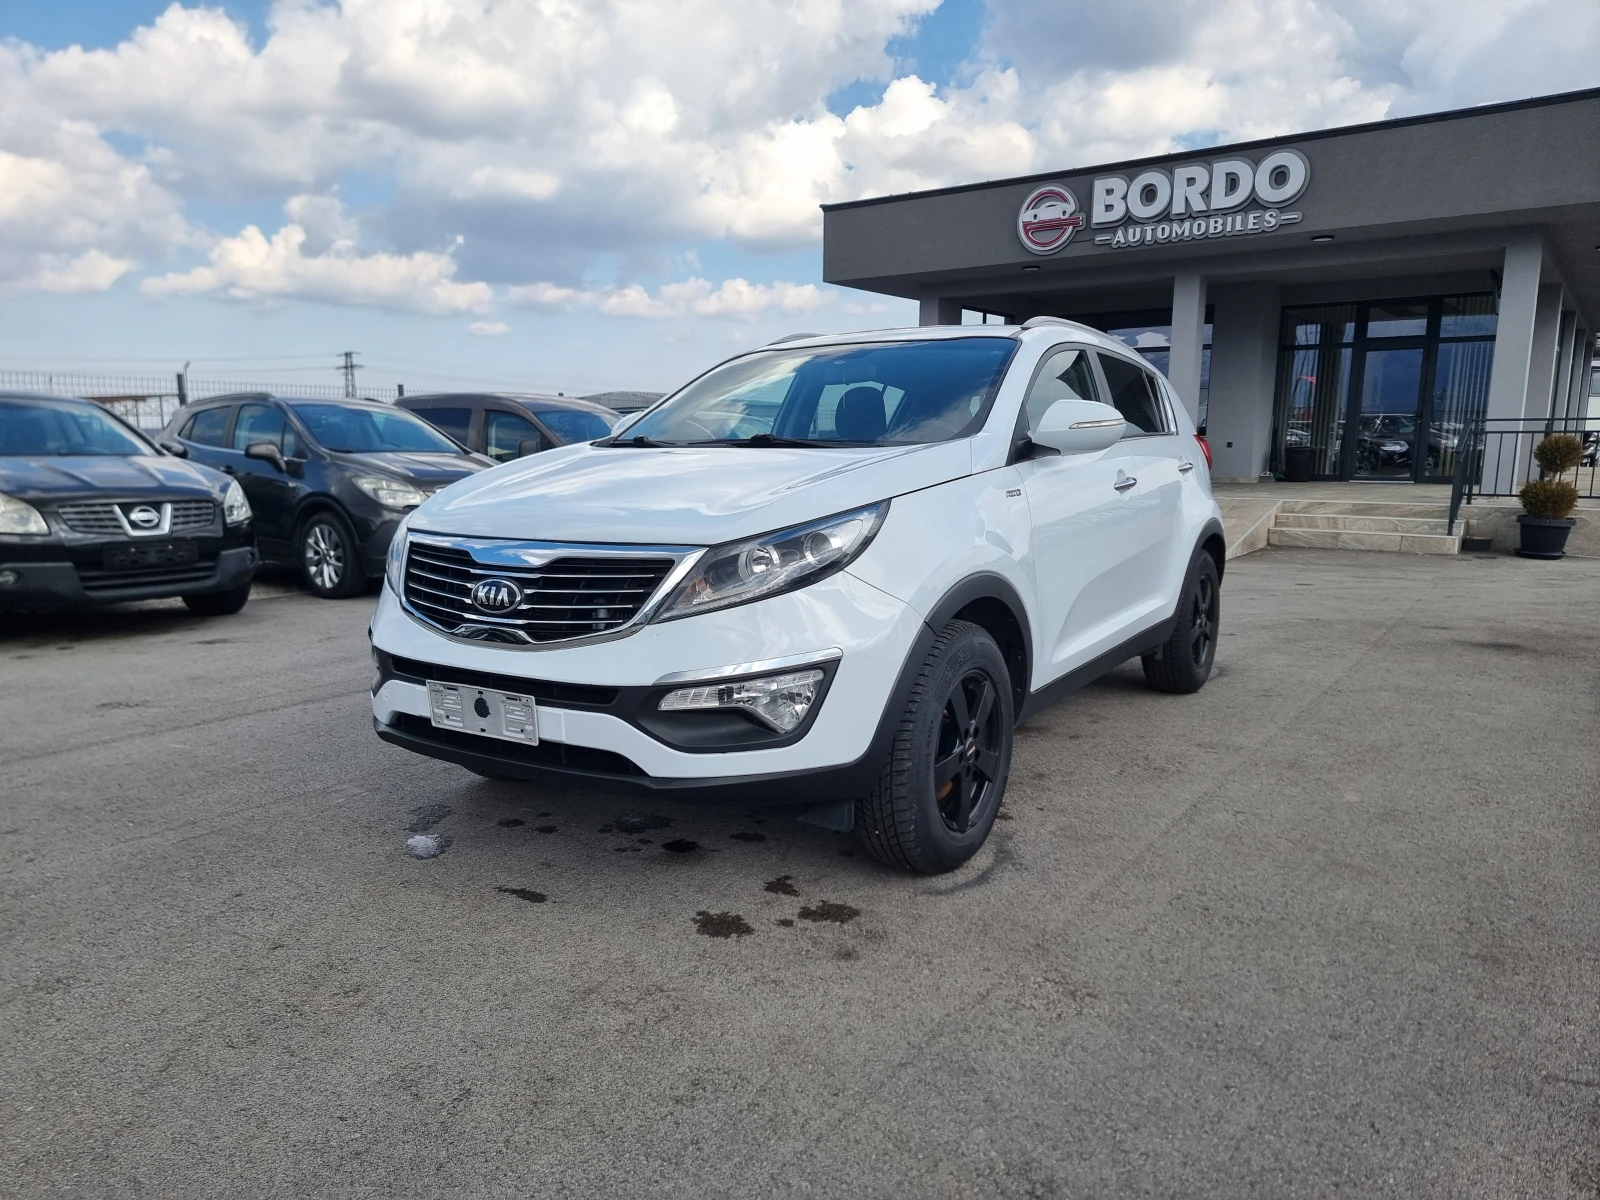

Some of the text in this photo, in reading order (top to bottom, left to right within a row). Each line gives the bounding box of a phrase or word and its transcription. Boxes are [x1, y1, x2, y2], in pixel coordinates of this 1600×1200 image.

[1092, 152, 1306, 224] BORDO
[1113, 210, 1277, 245] AUTOMOBILES
[477, 585, 510, 607] KIA
